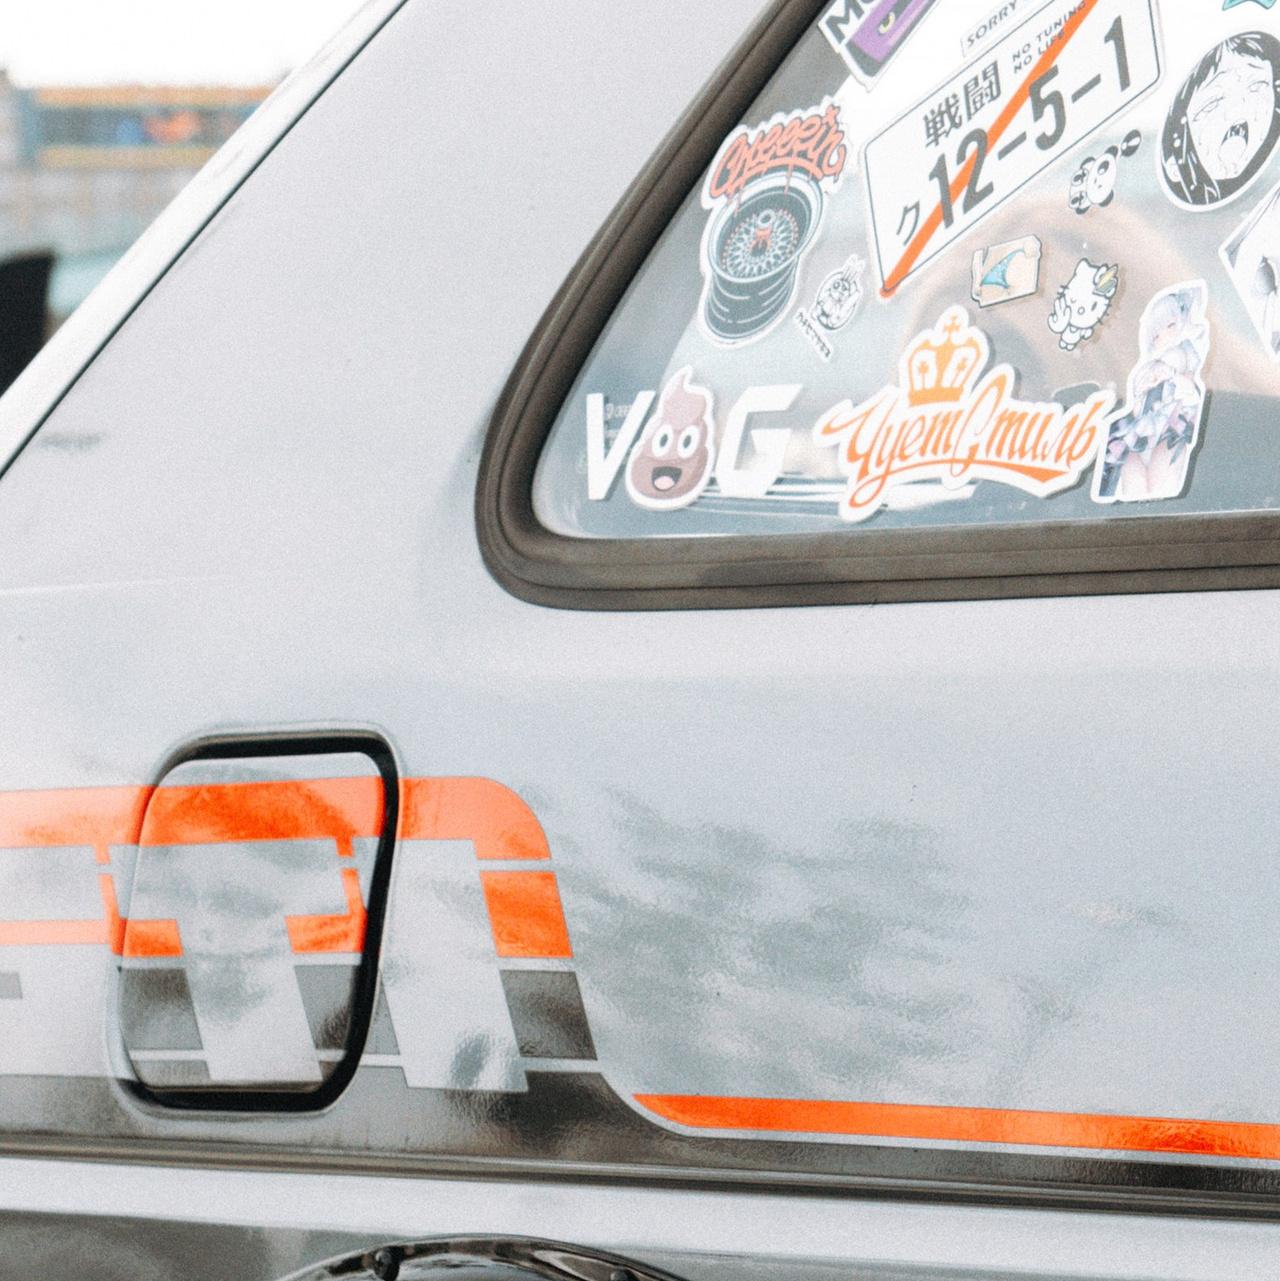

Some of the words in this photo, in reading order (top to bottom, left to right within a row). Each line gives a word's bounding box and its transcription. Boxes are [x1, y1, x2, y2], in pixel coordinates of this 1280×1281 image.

[1012, 42, 1031, 62] NO
[1036, 0, 1088, 42] TUNING
[1013, 54, 1033, 74] NO
[1037, 29, 1065, 55] LIFE
[923, 59, 1002, 149] 戦闘
[927, 14, 1131, 230] 12-5-1
